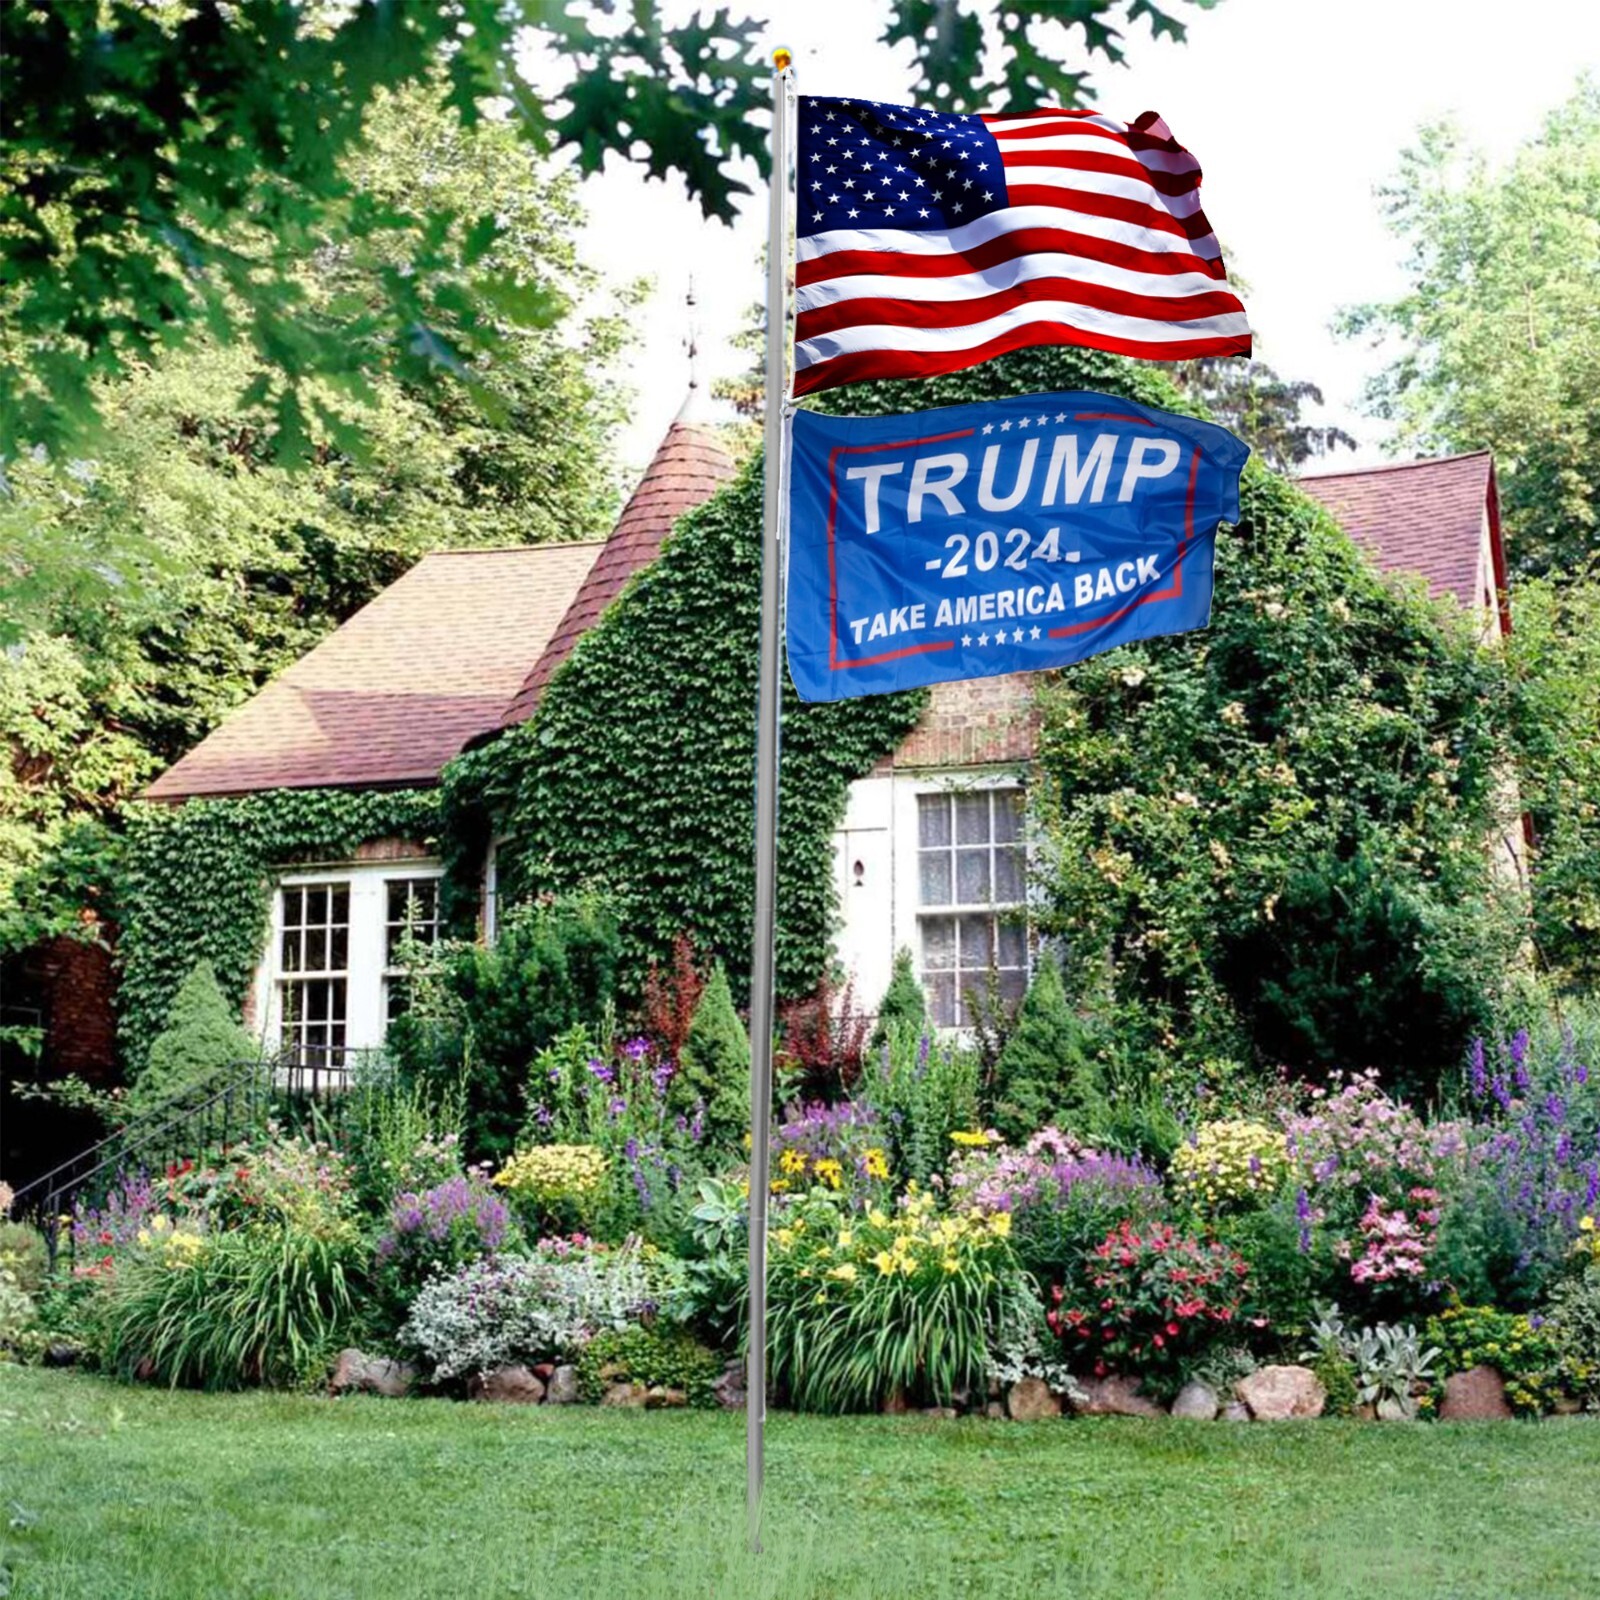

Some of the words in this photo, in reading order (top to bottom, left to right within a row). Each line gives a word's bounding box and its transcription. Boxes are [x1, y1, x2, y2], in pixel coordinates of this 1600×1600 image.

[846, 434, 1181, 534] TRUMP
[850, 603, 926, 645] TAKE
[934, 582, 1065, 627] AMERICA
[1074, 553, 1161, 608] BACK
